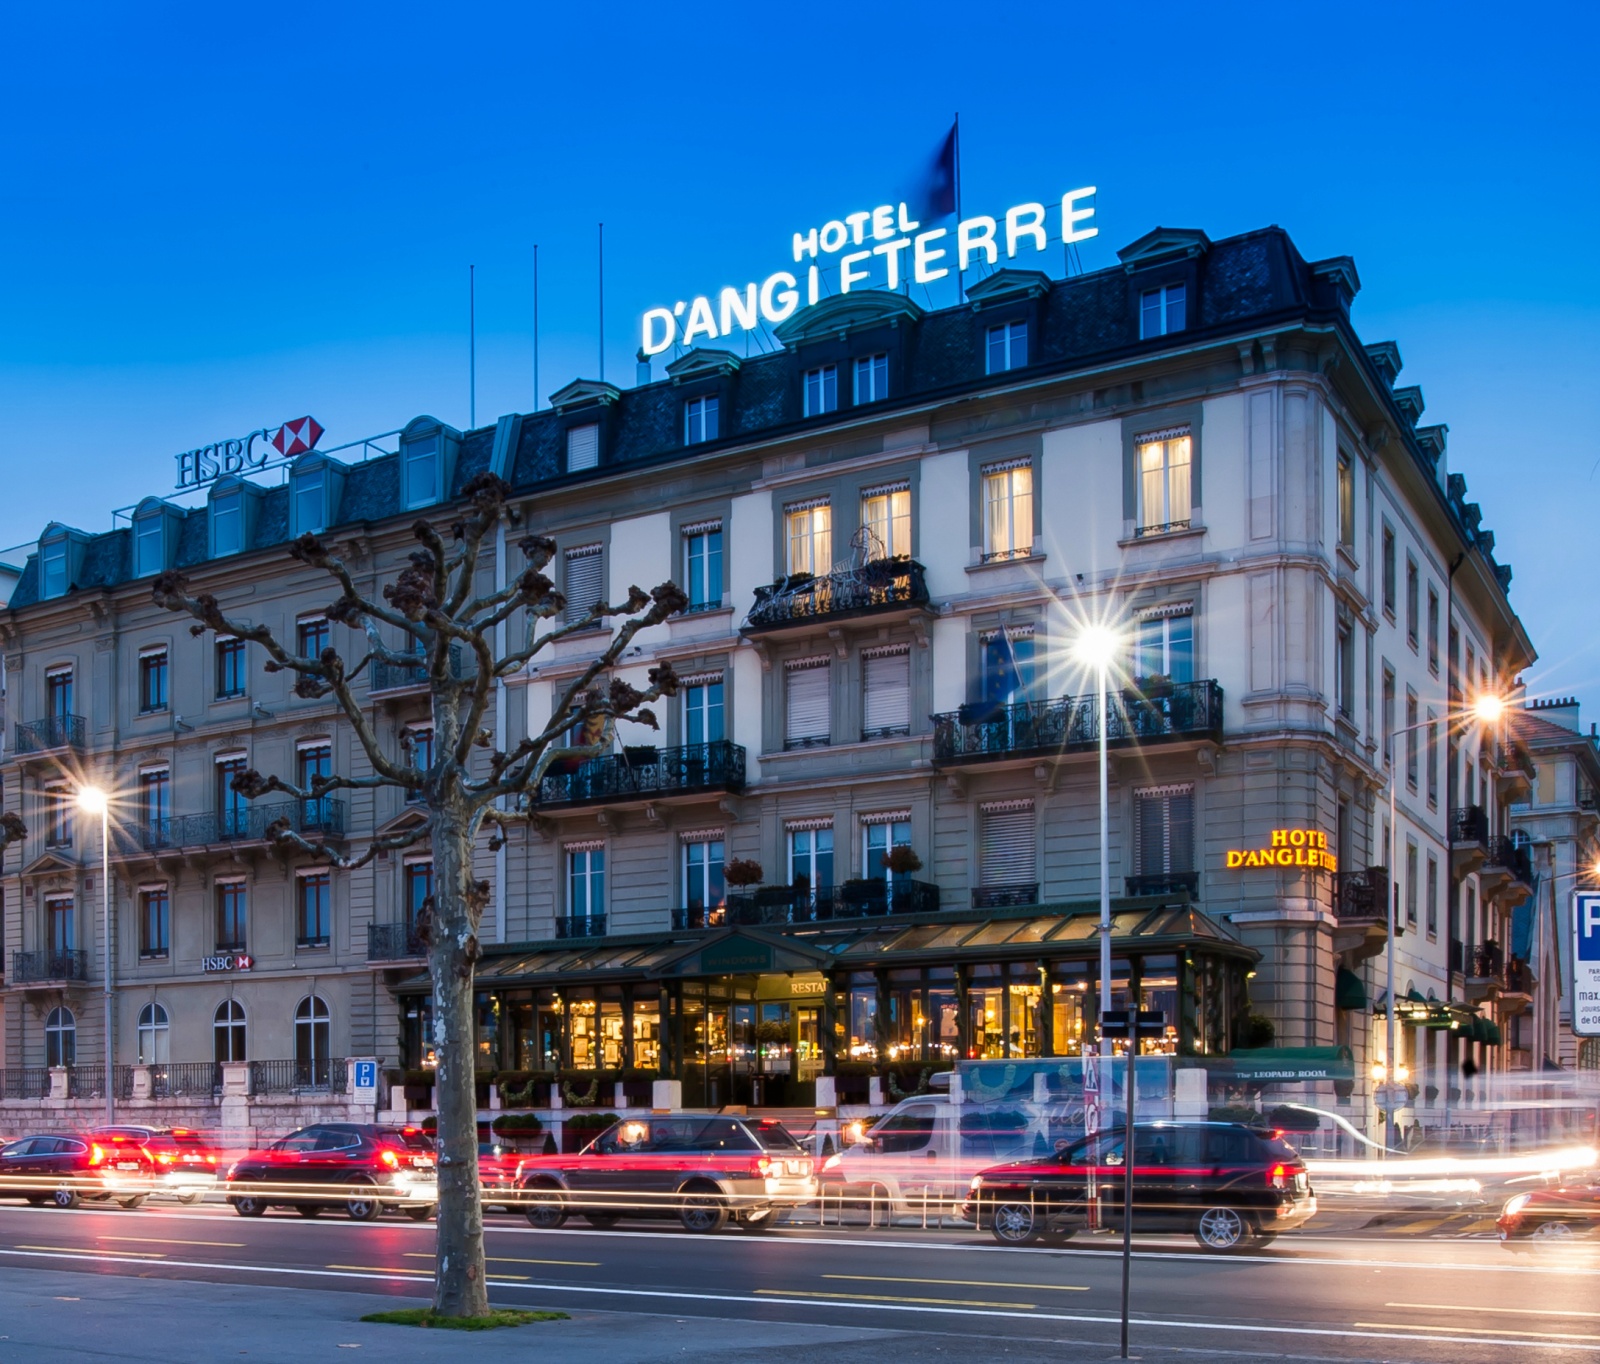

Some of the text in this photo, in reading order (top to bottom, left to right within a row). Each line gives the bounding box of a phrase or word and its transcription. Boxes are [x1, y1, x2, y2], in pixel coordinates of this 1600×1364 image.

[793, 202, 919, 262] HOTEL
[175, 429, 268, 489] HSBC
[202, 956, 232, 971] HSBC
[708, 954, 767, 966] WINDOWS
[1581, 1016, 1591, 1024] de
[362, 1064, 370, 1076] P
[1298, 1070, 1326, 1078] ROOM
